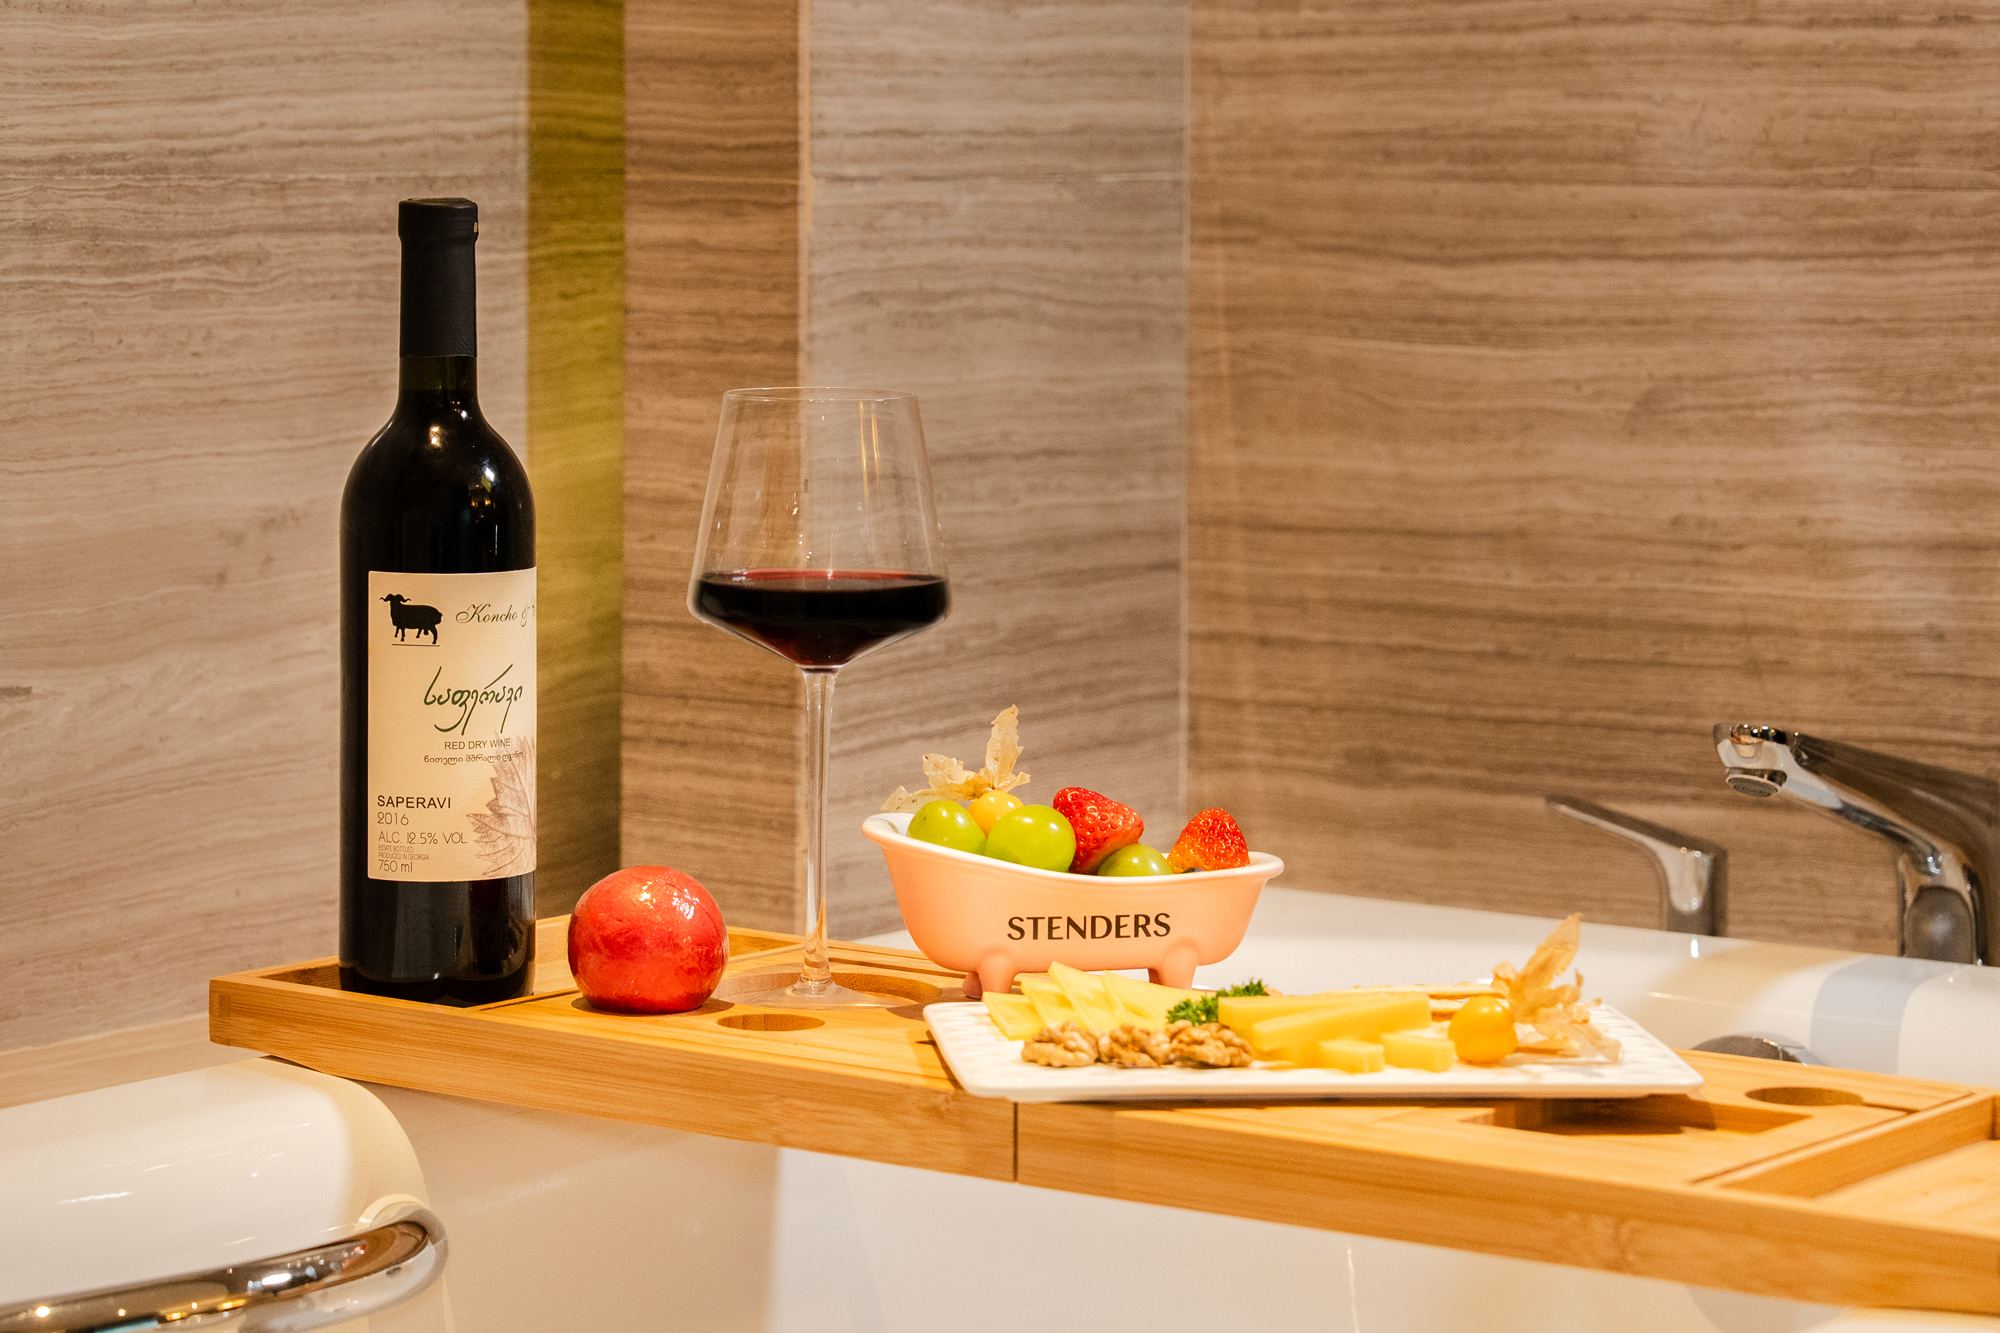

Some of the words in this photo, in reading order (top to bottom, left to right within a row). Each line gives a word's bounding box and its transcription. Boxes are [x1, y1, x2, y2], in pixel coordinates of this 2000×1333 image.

[455, 603, 518, 624] Koncho
[424, 663, 523, 736] საფერავი
[444, 741, 466, 750] RED
[468, 740, 488, 749] DRY
[490, 738, 511, 748] WINE
[423, 755, 464, 766] წითელი
[377, 795, 451, 809] SAPERAVI
[377, 811, 409, 826] 2016
[378, 830, 403, 844] ALC.
[406, 831, 438, 845] 12.5%
[442, 831, 468, 844] VOL
[378, 844, 393, 853] ESTATE
[393, 845, 414, 853] BOTTLED
[378, 851, 402, 860] PRODUCED
[408, 853, 430, 861] GEORGIA
[378, 859, 398, 872] 750
[400, 861, 413, 873] ml
[1006, 912, 1171, 941] STENDERS
